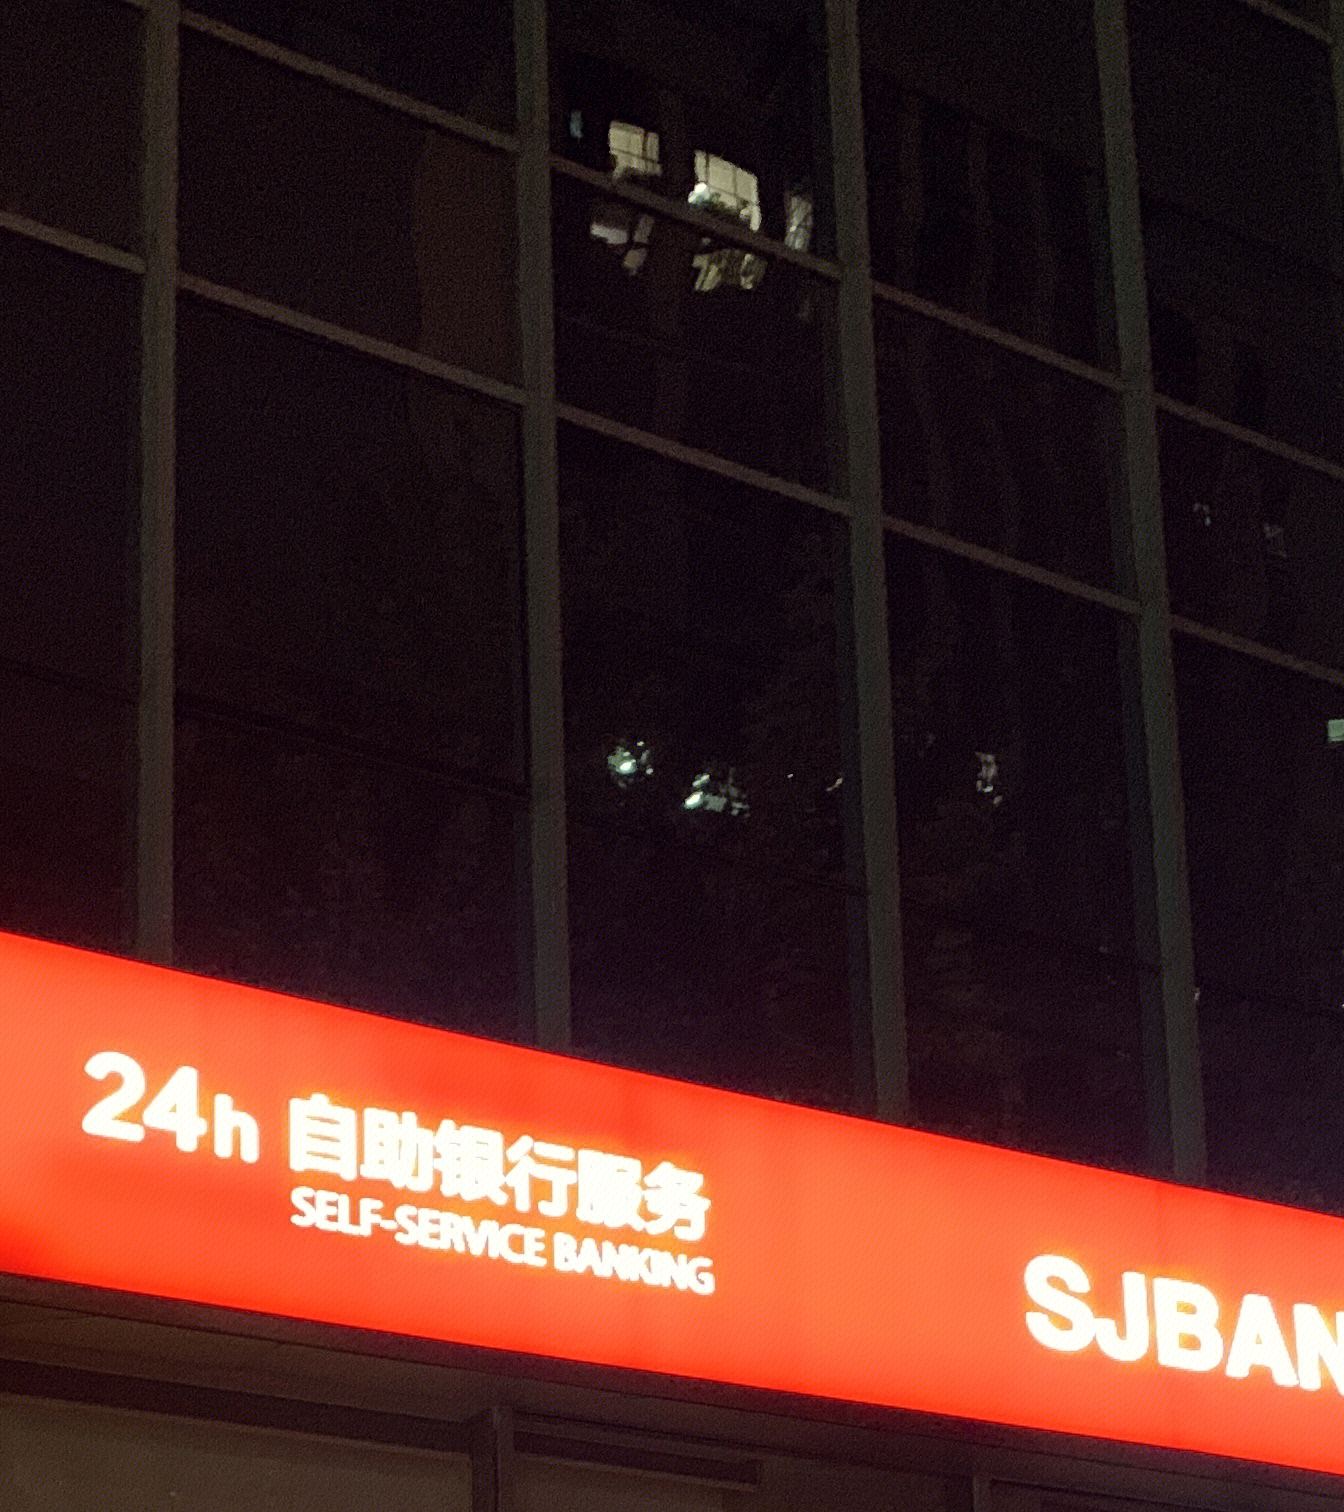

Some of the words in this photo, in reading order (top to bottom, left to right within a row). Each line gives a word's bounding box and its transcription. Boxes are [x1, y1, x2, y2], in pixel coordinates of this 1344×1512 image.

[82, 1051, 259, 1163] 24h
[288, 1093, 711, 1242] 自助银行服务
[291, 1186, 547, 1268] SELF-SERVICE
[552, 1232, 715, 1295] BANKING
